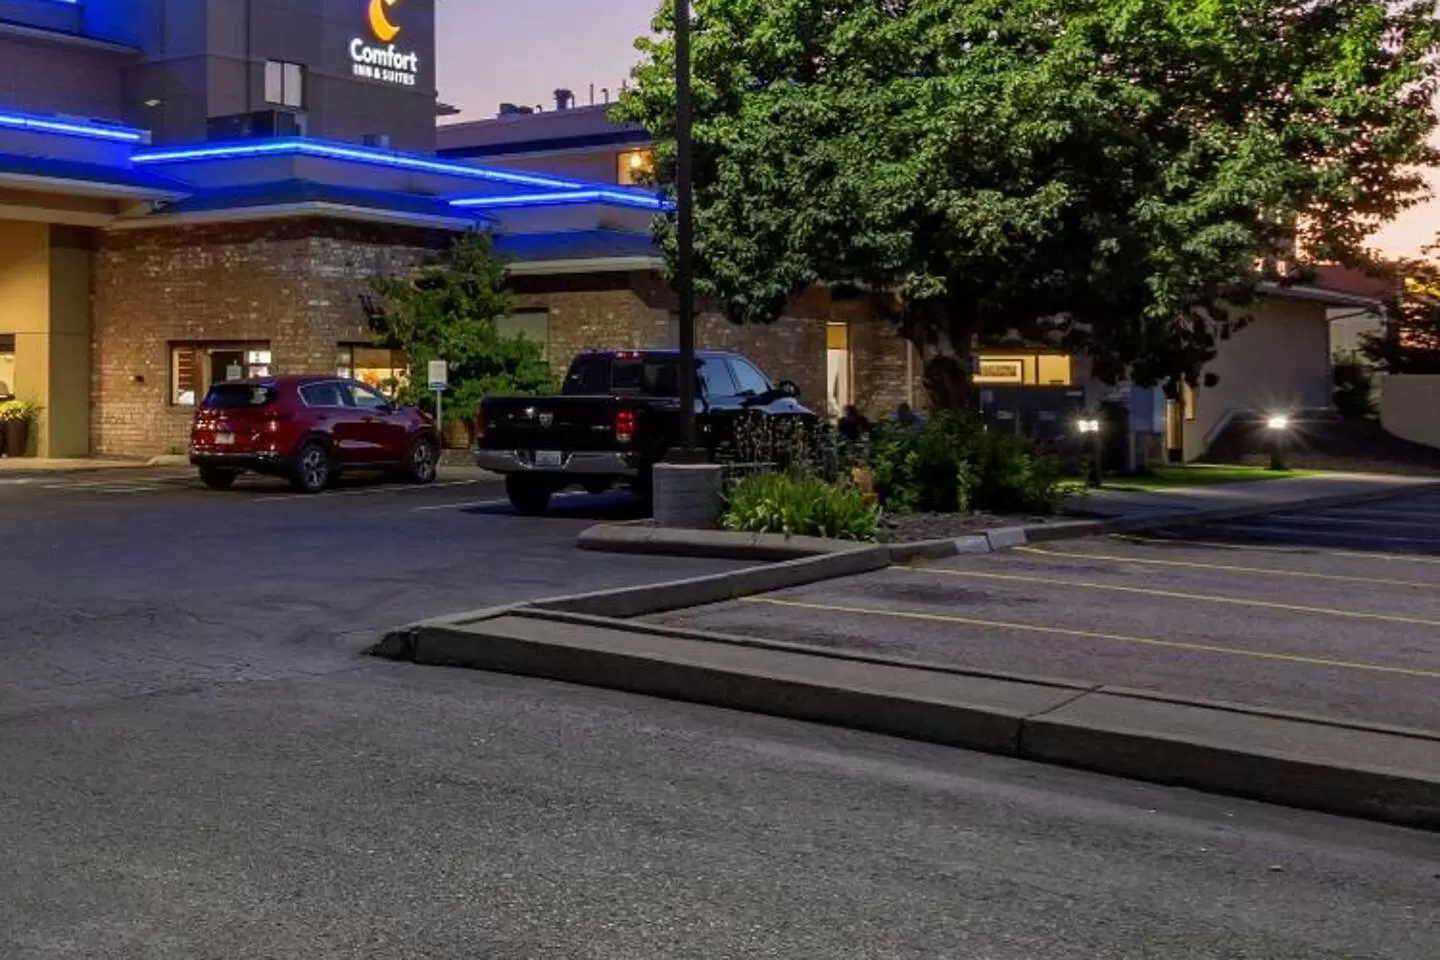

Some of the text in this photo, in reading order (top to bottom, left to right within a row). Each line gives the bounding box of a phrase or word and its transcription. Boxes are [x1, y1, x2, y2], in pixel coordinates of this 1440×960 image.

[350, 38, 417, 73] Comfort
[353, 63, 415, 85] INN & SUITES
